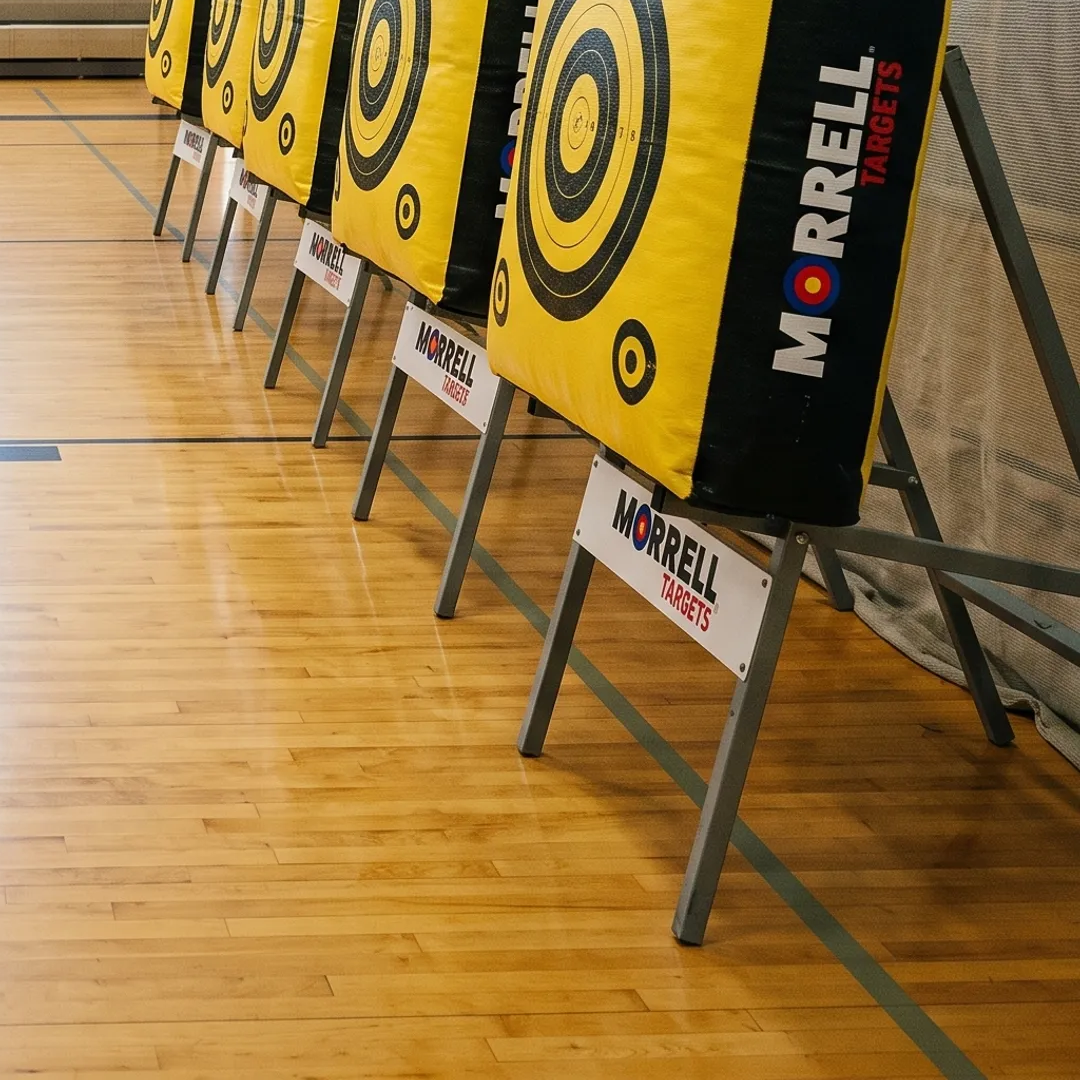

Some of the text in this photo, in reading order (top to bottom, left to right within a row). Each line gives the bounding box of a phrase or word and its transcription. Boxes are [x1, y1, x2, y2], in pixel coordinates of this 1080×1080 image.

[860, 59, 904, 186] TARGETS
[772, 55, 875, 379] MORRELL
[415, 321, 476, 388] MORRELL
[611, 488, 720, 606] MORRELL
[660, 572, 713, 633] TARGETS
